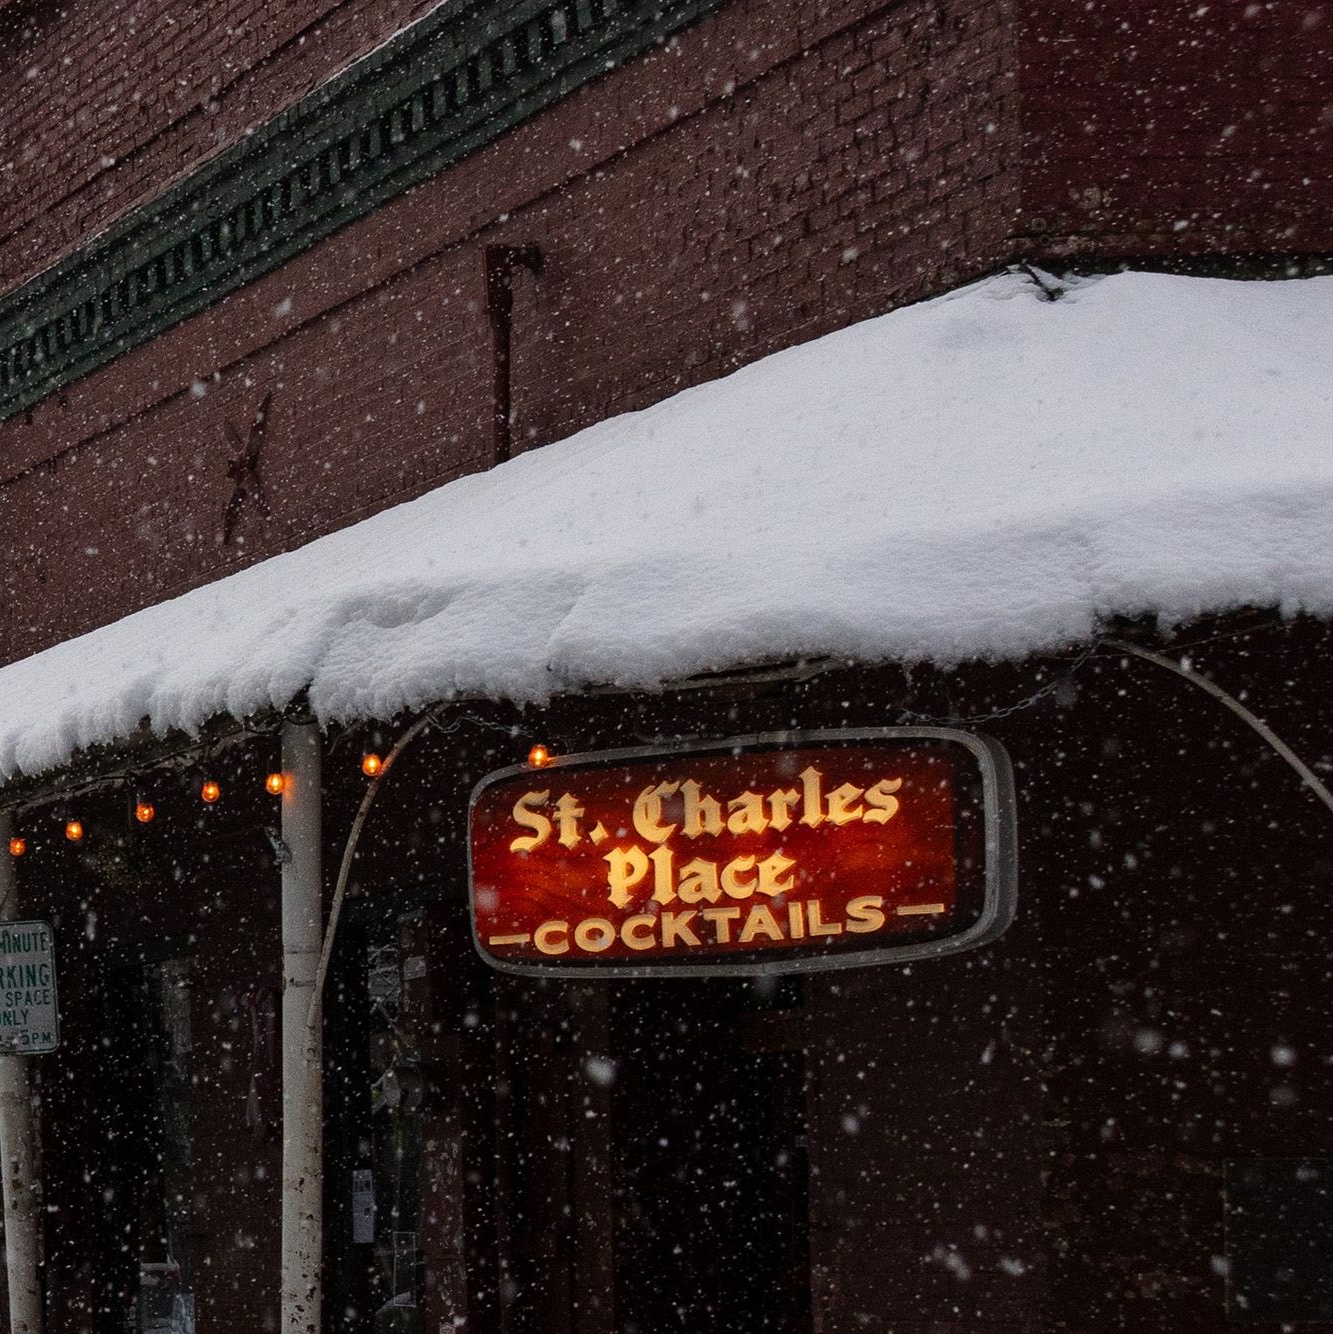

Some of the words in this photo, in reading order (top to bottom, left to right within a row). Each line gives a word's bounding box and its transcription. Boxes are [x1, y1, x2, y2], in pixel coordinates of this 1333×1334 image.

[508, 788, 608, 853] St.
[633, 766, 904, 843] Charles
[603, 843, 798, 909] Place
[533, 896, 886, 955] COCKTAILS
[5, 989, 51, 1008] SPACE
